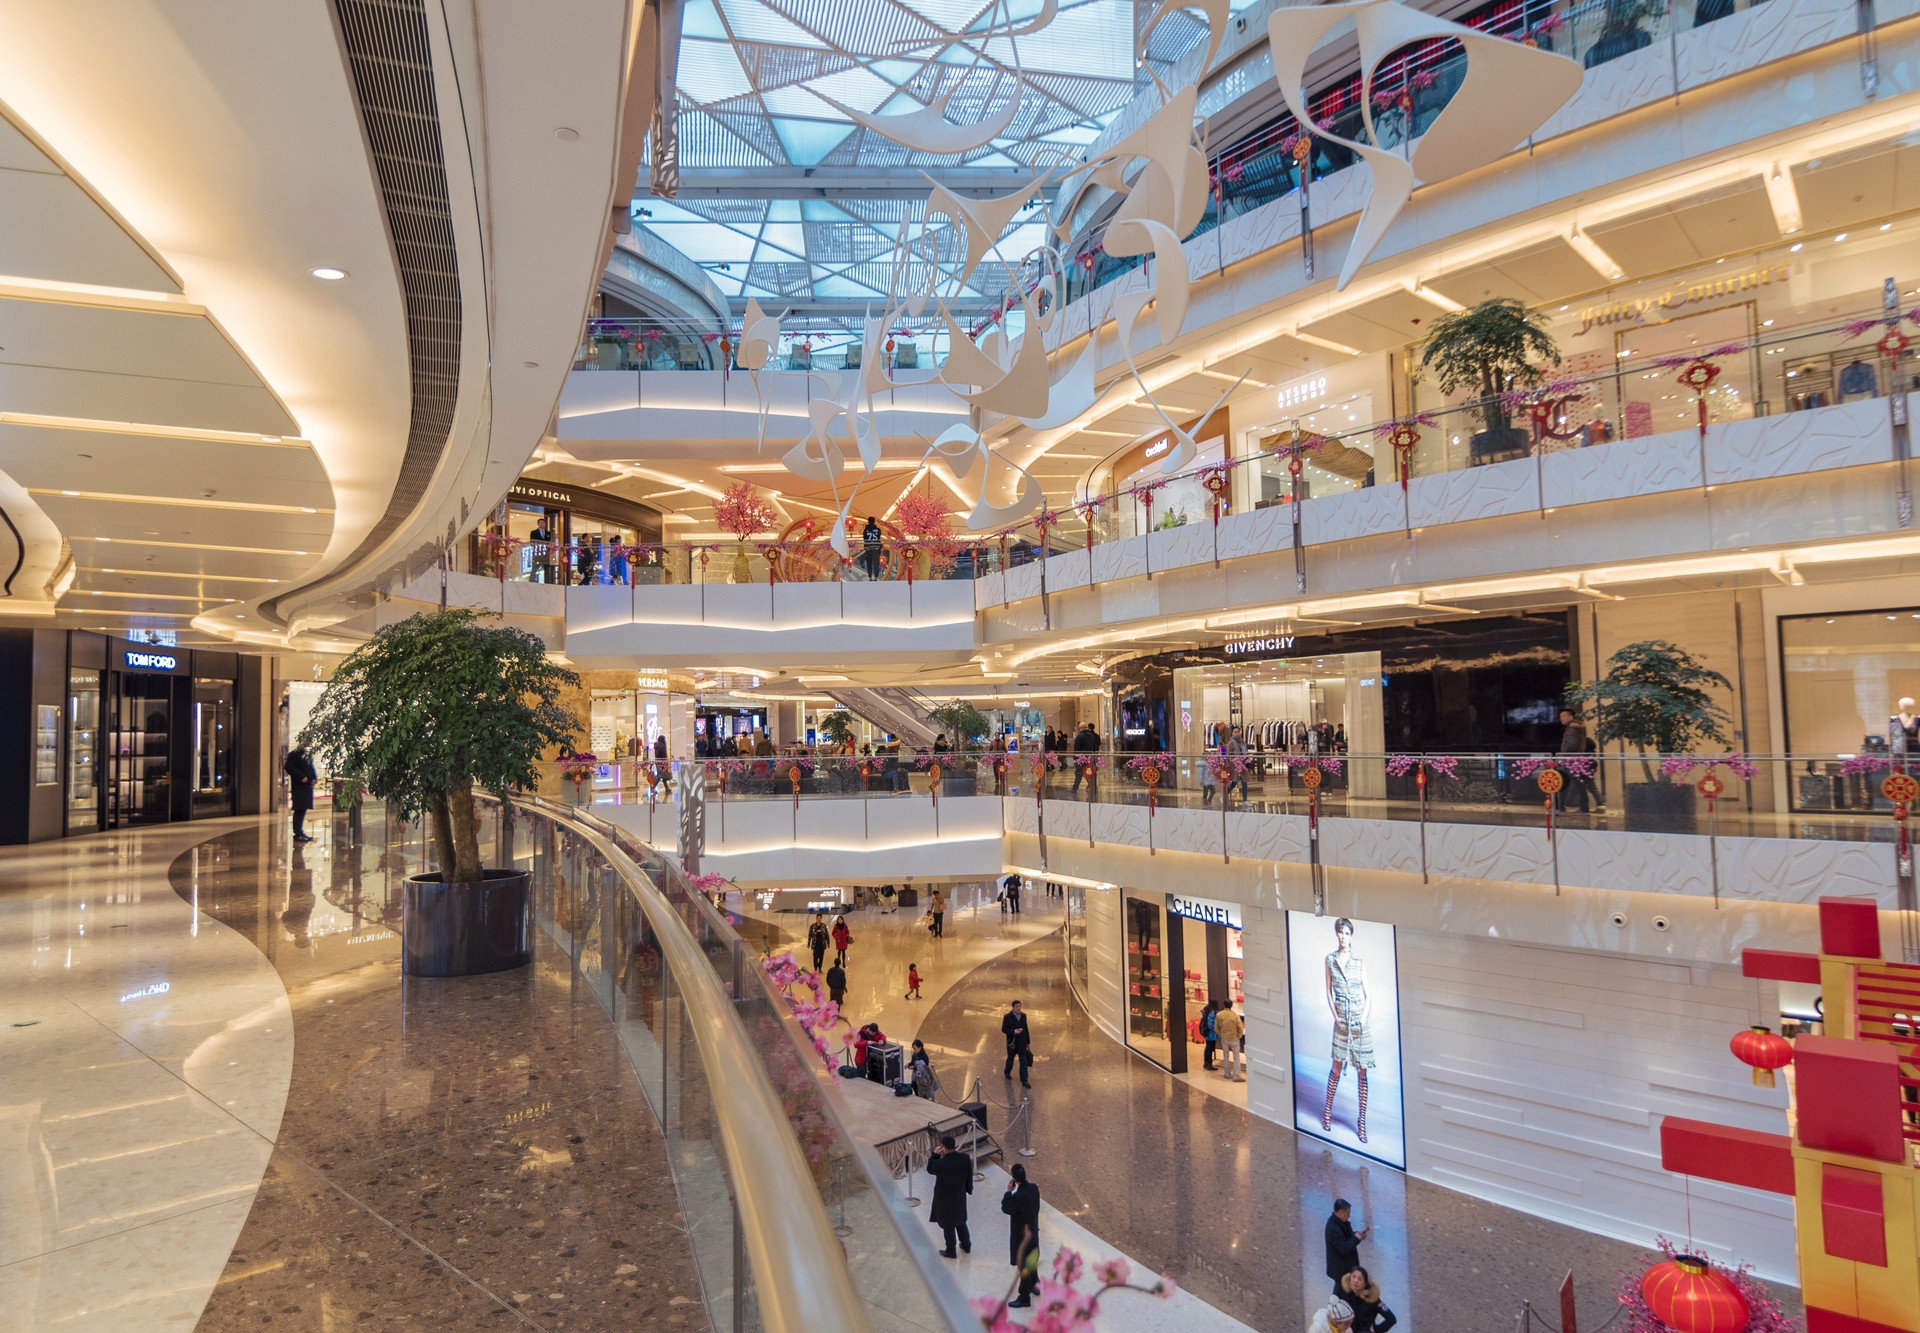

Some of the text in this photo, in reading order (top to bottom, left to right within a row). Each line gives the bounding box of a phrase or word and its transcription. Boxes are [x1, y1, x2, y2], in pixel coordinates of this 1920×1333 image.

[1277, 377, 1326, 403] ATSURO
[528, 488, 571, 502] OPTICAL
[1225, 636, 1295, 654] GIVENCHY
[127, 652, 176, 669] TOM FORD
[638, 677, 669, 688] VERSACE
[1173, 898, 1234, 926] CHANEL
